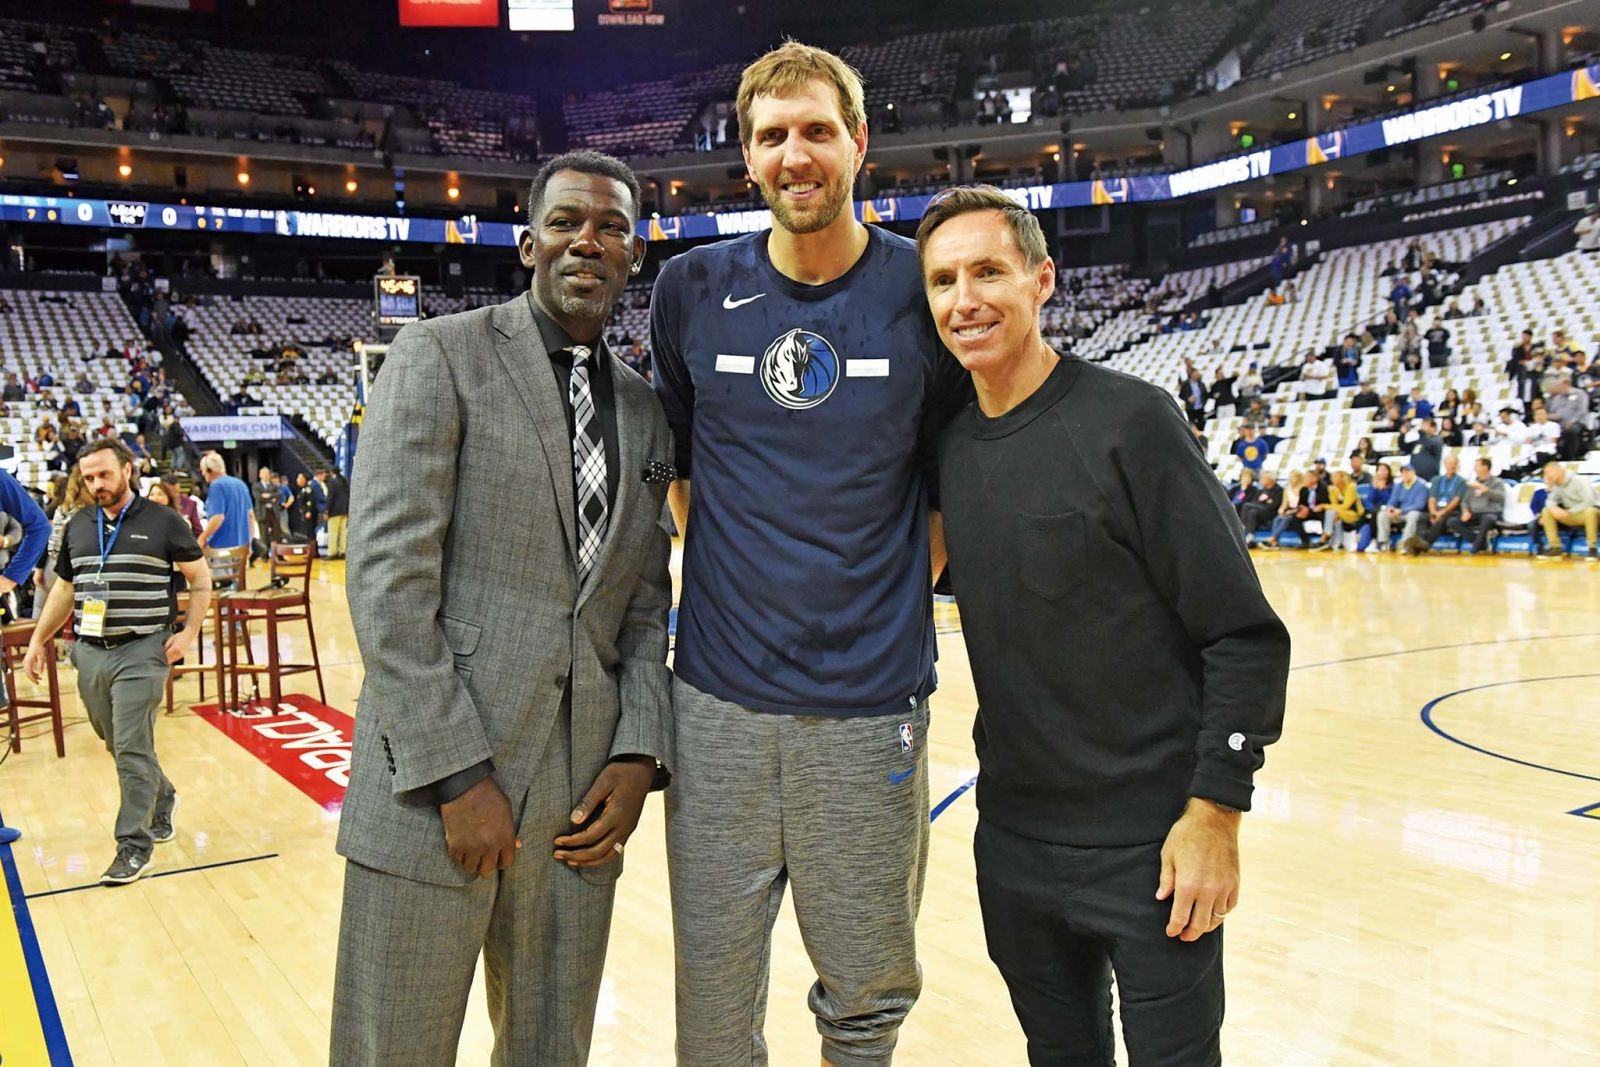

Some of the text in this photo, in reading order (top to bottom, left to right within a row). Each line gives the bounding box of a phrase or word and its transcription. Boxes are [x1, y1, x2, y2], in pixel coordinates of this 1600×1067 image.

[1382, 85, 1523, 146] WARRIORS TV
[1168, 150, 1271, 197] WARRIORS TV
[1028, 185, 1053, 209] TV
[77, 203, 93, 222] 0
[163, 208, 177, 225] 0
[297, 212, 410, 241] WARRIORS TV
